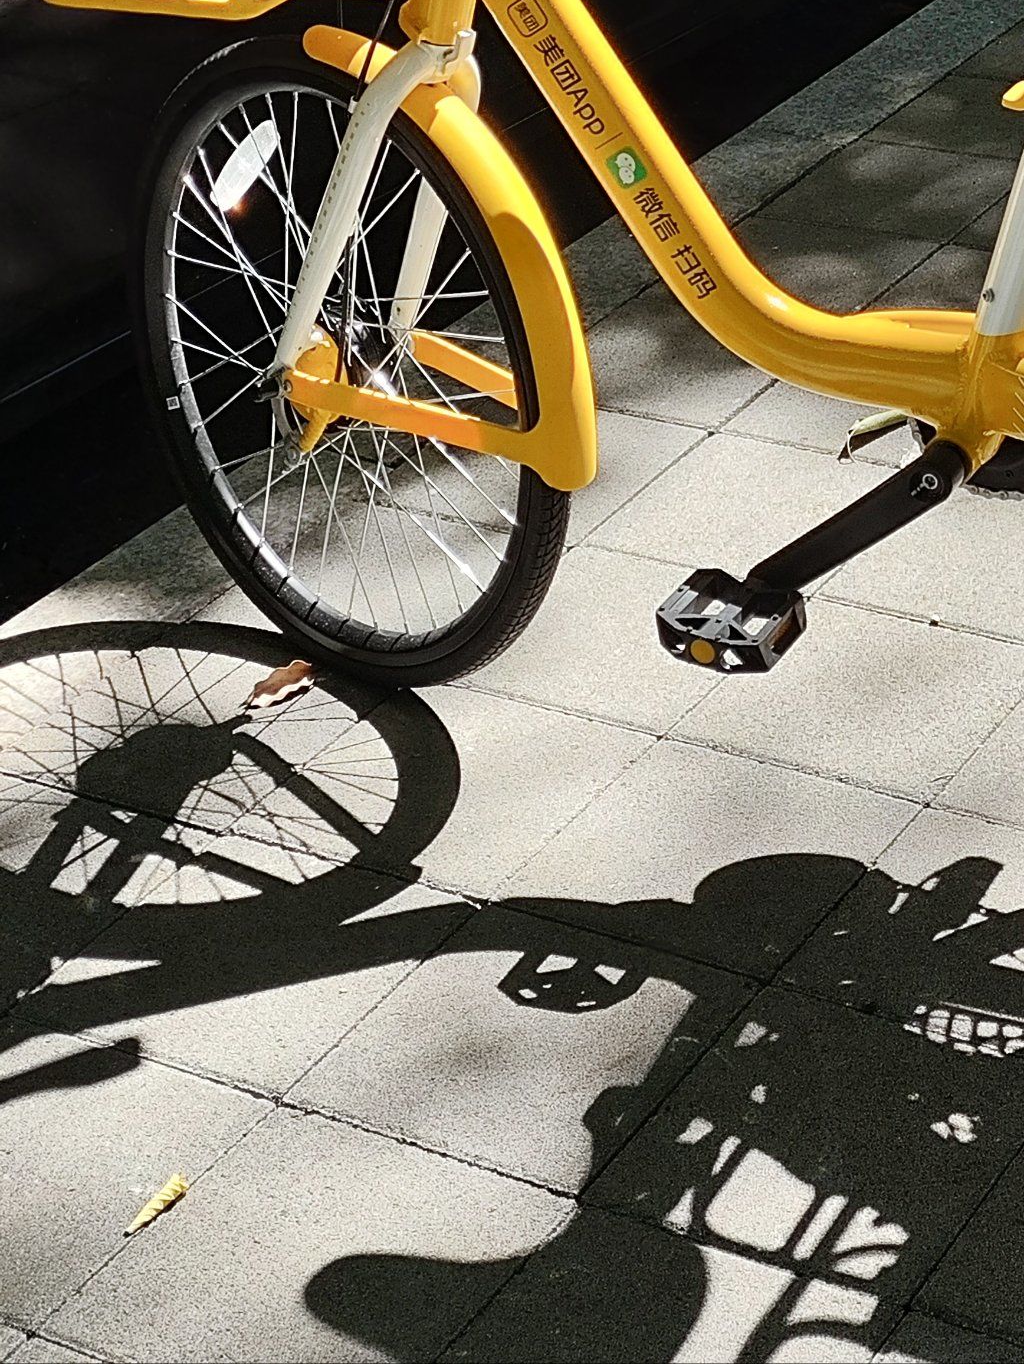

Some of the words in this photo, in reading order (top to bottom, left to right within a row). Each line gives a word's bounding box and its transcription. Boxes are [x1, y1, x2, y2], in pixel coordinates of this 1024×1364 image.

[513, 2, 540, 32] 美团
[533, 34, 606, 136] 美团App
[632, 187, 680, 243] 微信
[670, 244, 718, 300] 扫码
